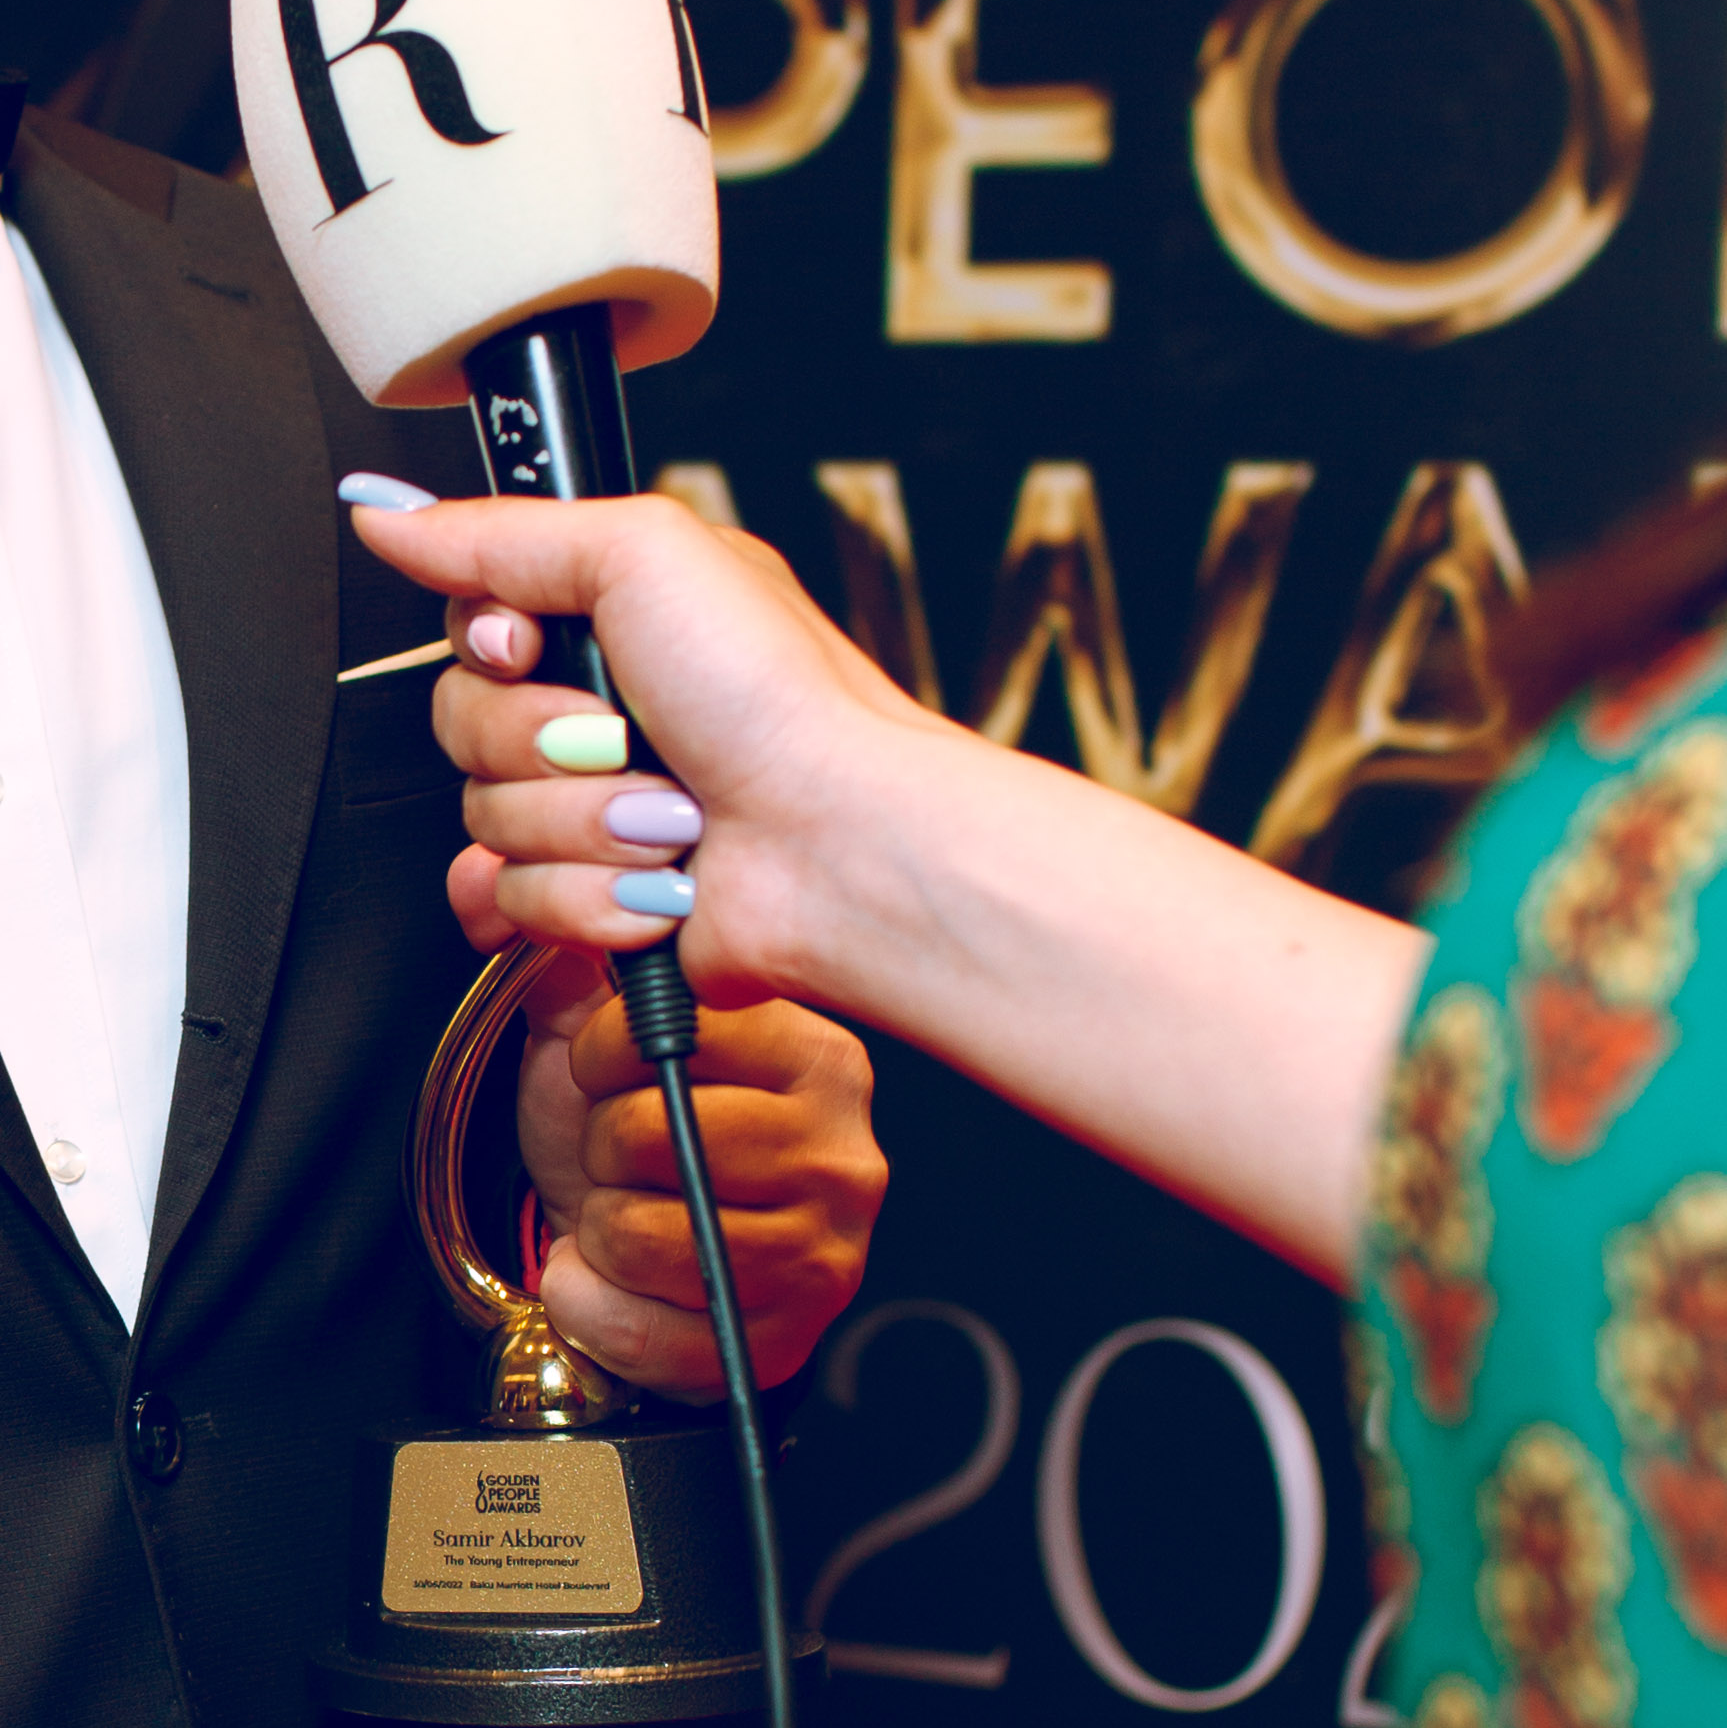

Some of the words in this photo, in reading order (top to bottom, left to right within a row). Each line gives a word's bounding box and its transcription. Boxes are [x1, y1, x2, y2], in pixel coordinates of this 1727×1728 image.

[485, 1474, 540, 1486] GOLDEN
[488, 1488, 540, 1501] PEOPLE
[487, 1502, 541, 1514] AWARDS
[433, 1529, 495, 1548] Samir
[500, 1528, 586, 1548] Akbarov
[444, 1555, 465, 1566] The
[467, 1555, 503, 1569] Young
[506, 1555, 580, 1569] Entrepreneur
[496, 1580, 534, 1590] Marriott
[535, 1580, 562, 1590] Hotel
